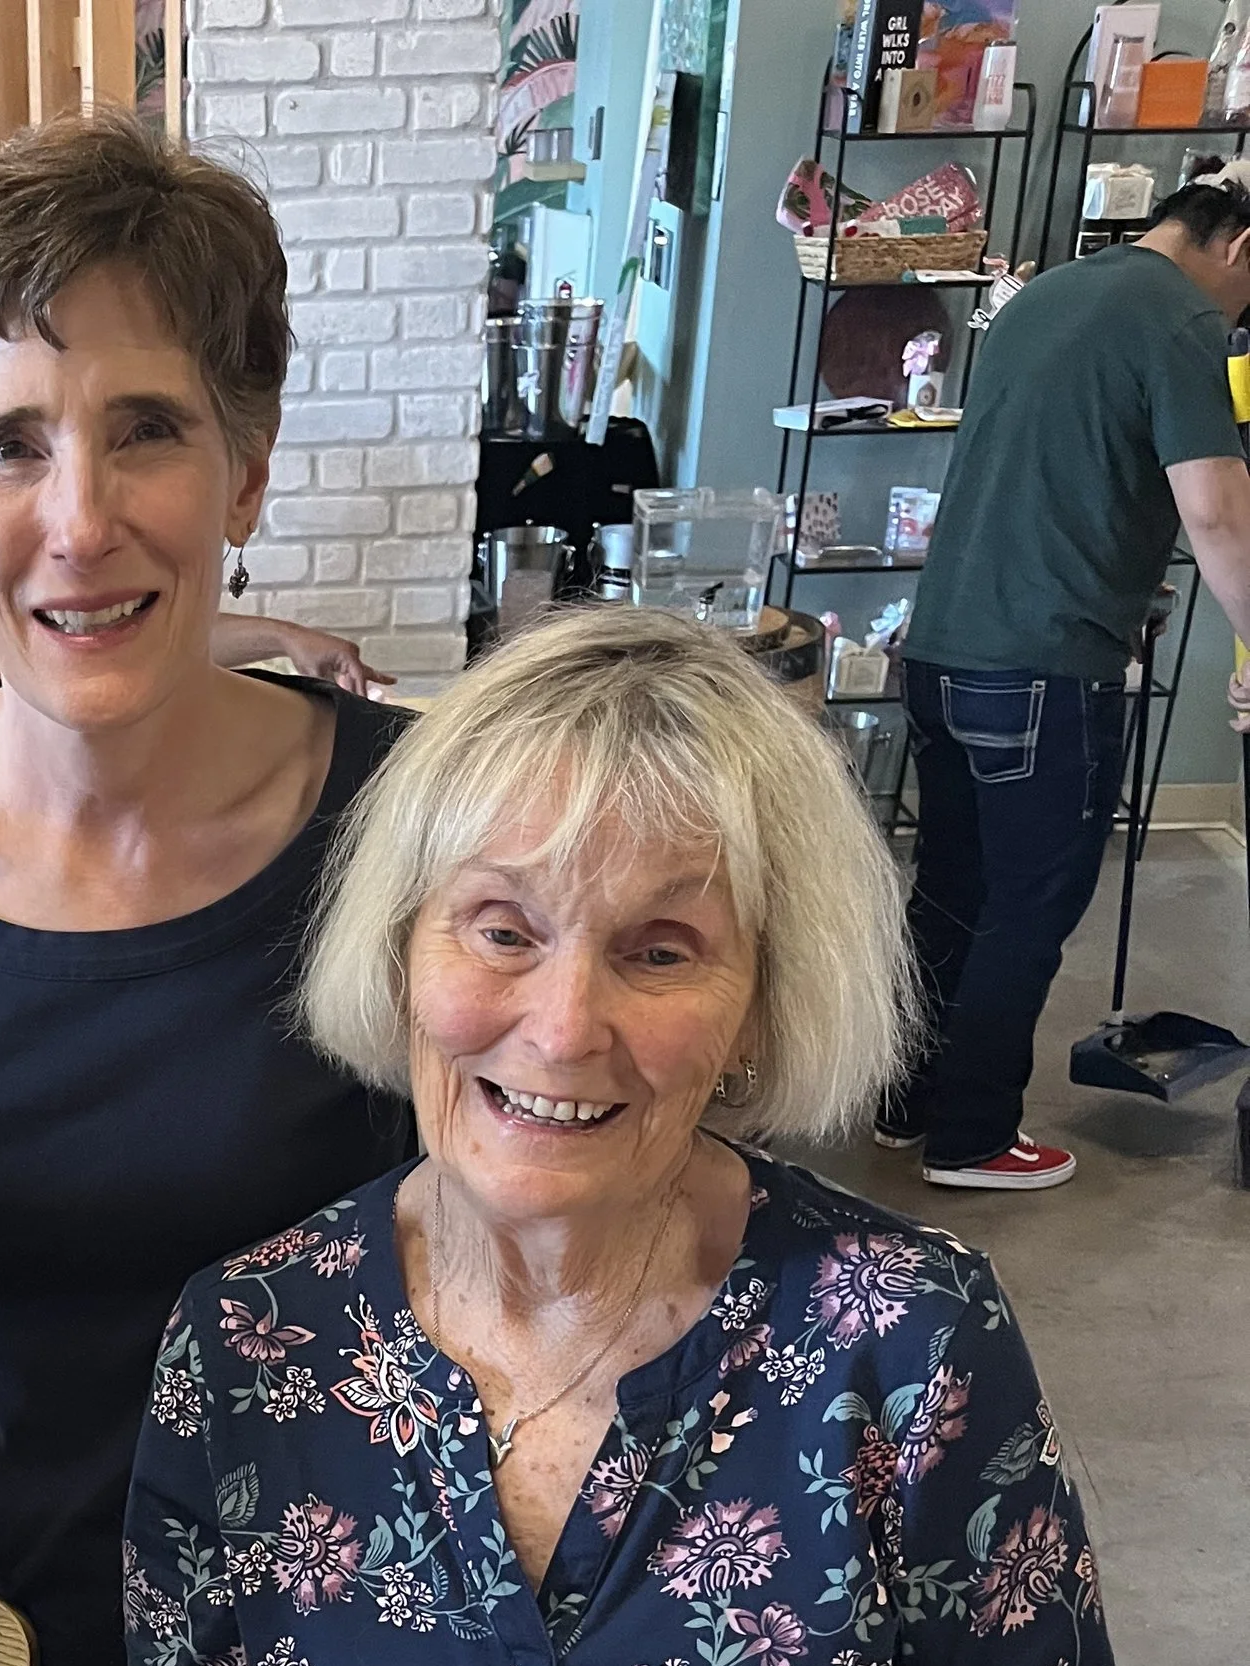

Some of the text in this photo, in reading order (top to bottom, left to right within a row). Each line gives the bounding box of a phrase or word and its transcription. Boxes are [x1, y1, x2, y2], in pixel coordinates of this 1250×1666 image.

[887, 16, 907, 31] GRL
[882, 33, 910, 48] WLKS
[880, 50, 906, 65] INTO
[853, 52, 864, 79] INTO
